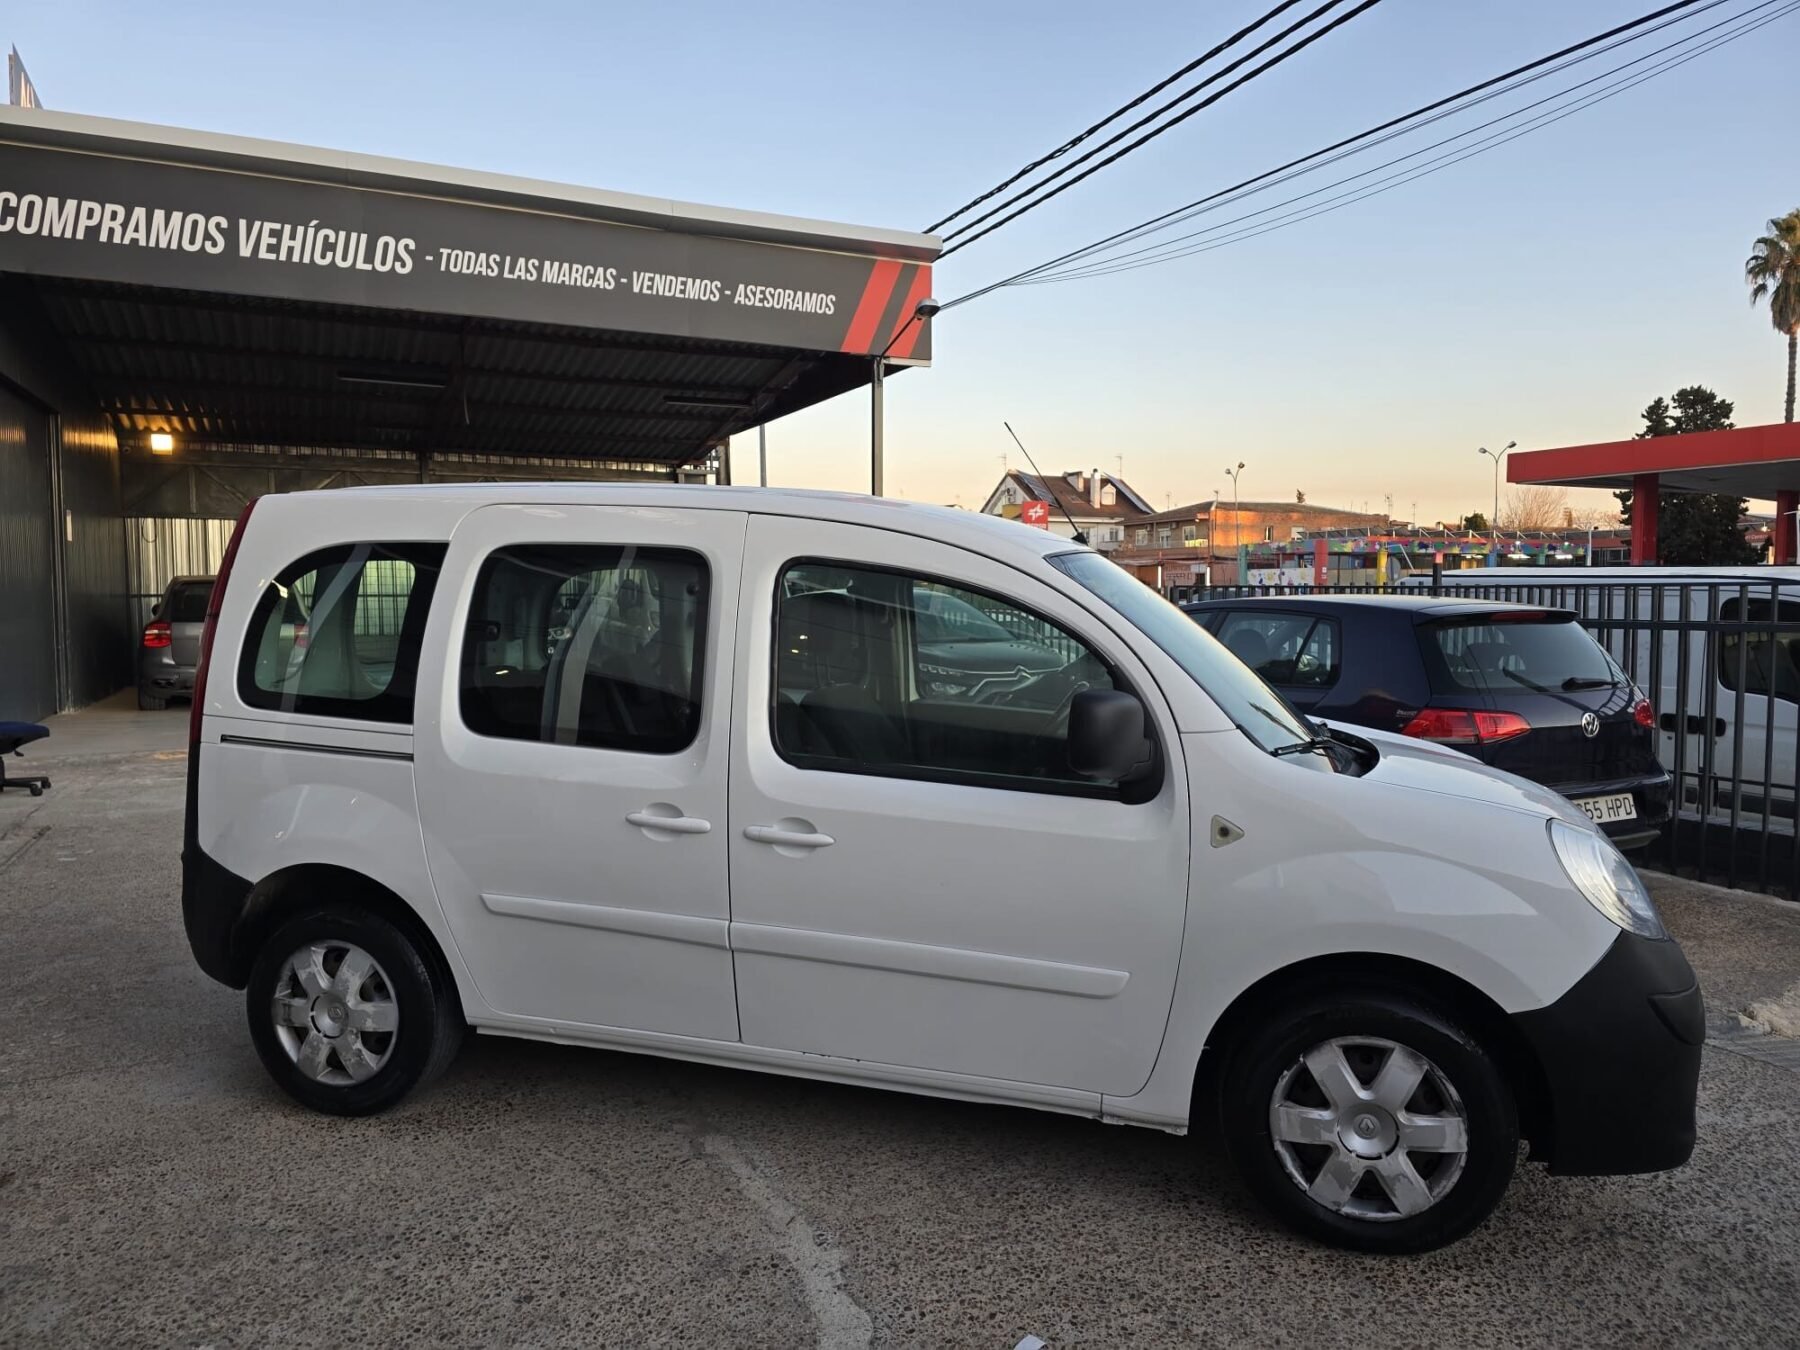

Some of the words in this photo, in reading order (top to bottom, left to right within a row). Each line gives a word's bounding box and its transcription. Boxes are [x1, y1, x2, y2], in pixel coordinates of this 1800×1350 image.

[0, 191, 229, 255] COMPRAMOS
[238, 218, 416, 275] VEHÍCULOS
[439, 247, 501, 278] TODAS
[502, 255, 540, 282] LAS
[541, 260, 618, 291] MARCAS
[632, 270, 722, 303] VENDEMOS
[733, 283, 837, 316] ASESORAMOS
[1576, 801, 1603, 820] 55
[1605, 797, 1633, 818] HPD
